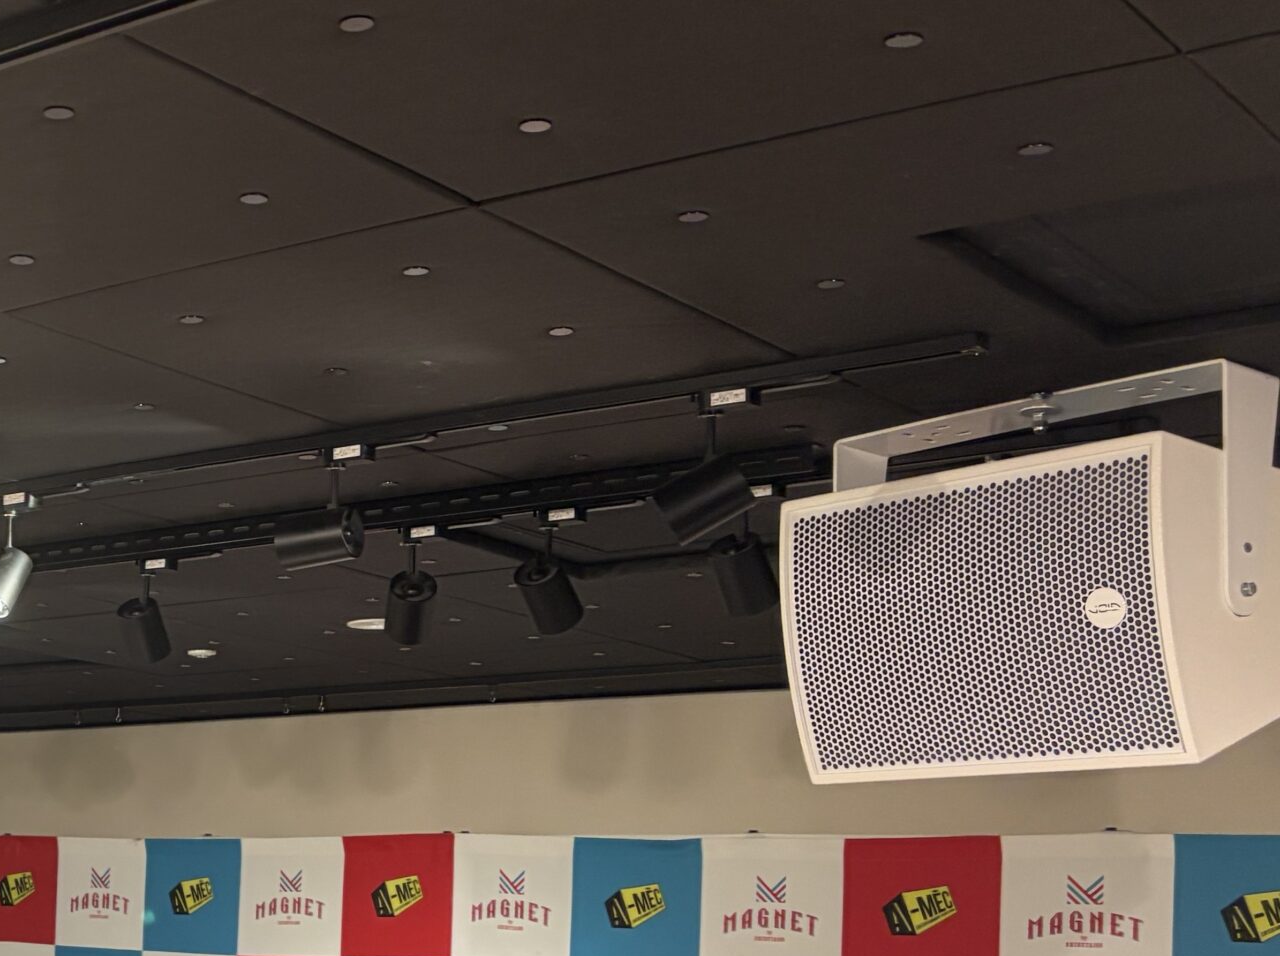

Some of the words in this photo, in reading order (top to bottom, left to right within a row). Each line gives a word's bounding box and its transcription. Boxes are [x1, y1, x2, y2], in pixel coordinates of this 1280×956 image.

[71, 893, 129, 914] MAGNET
[256, 897, 325, 919] MAGNET
[471, 897, 552, 927] MAGNET
[723, 908, 818, 937] MAGNET
[1027, 911, 1144, 941] MAGNET
